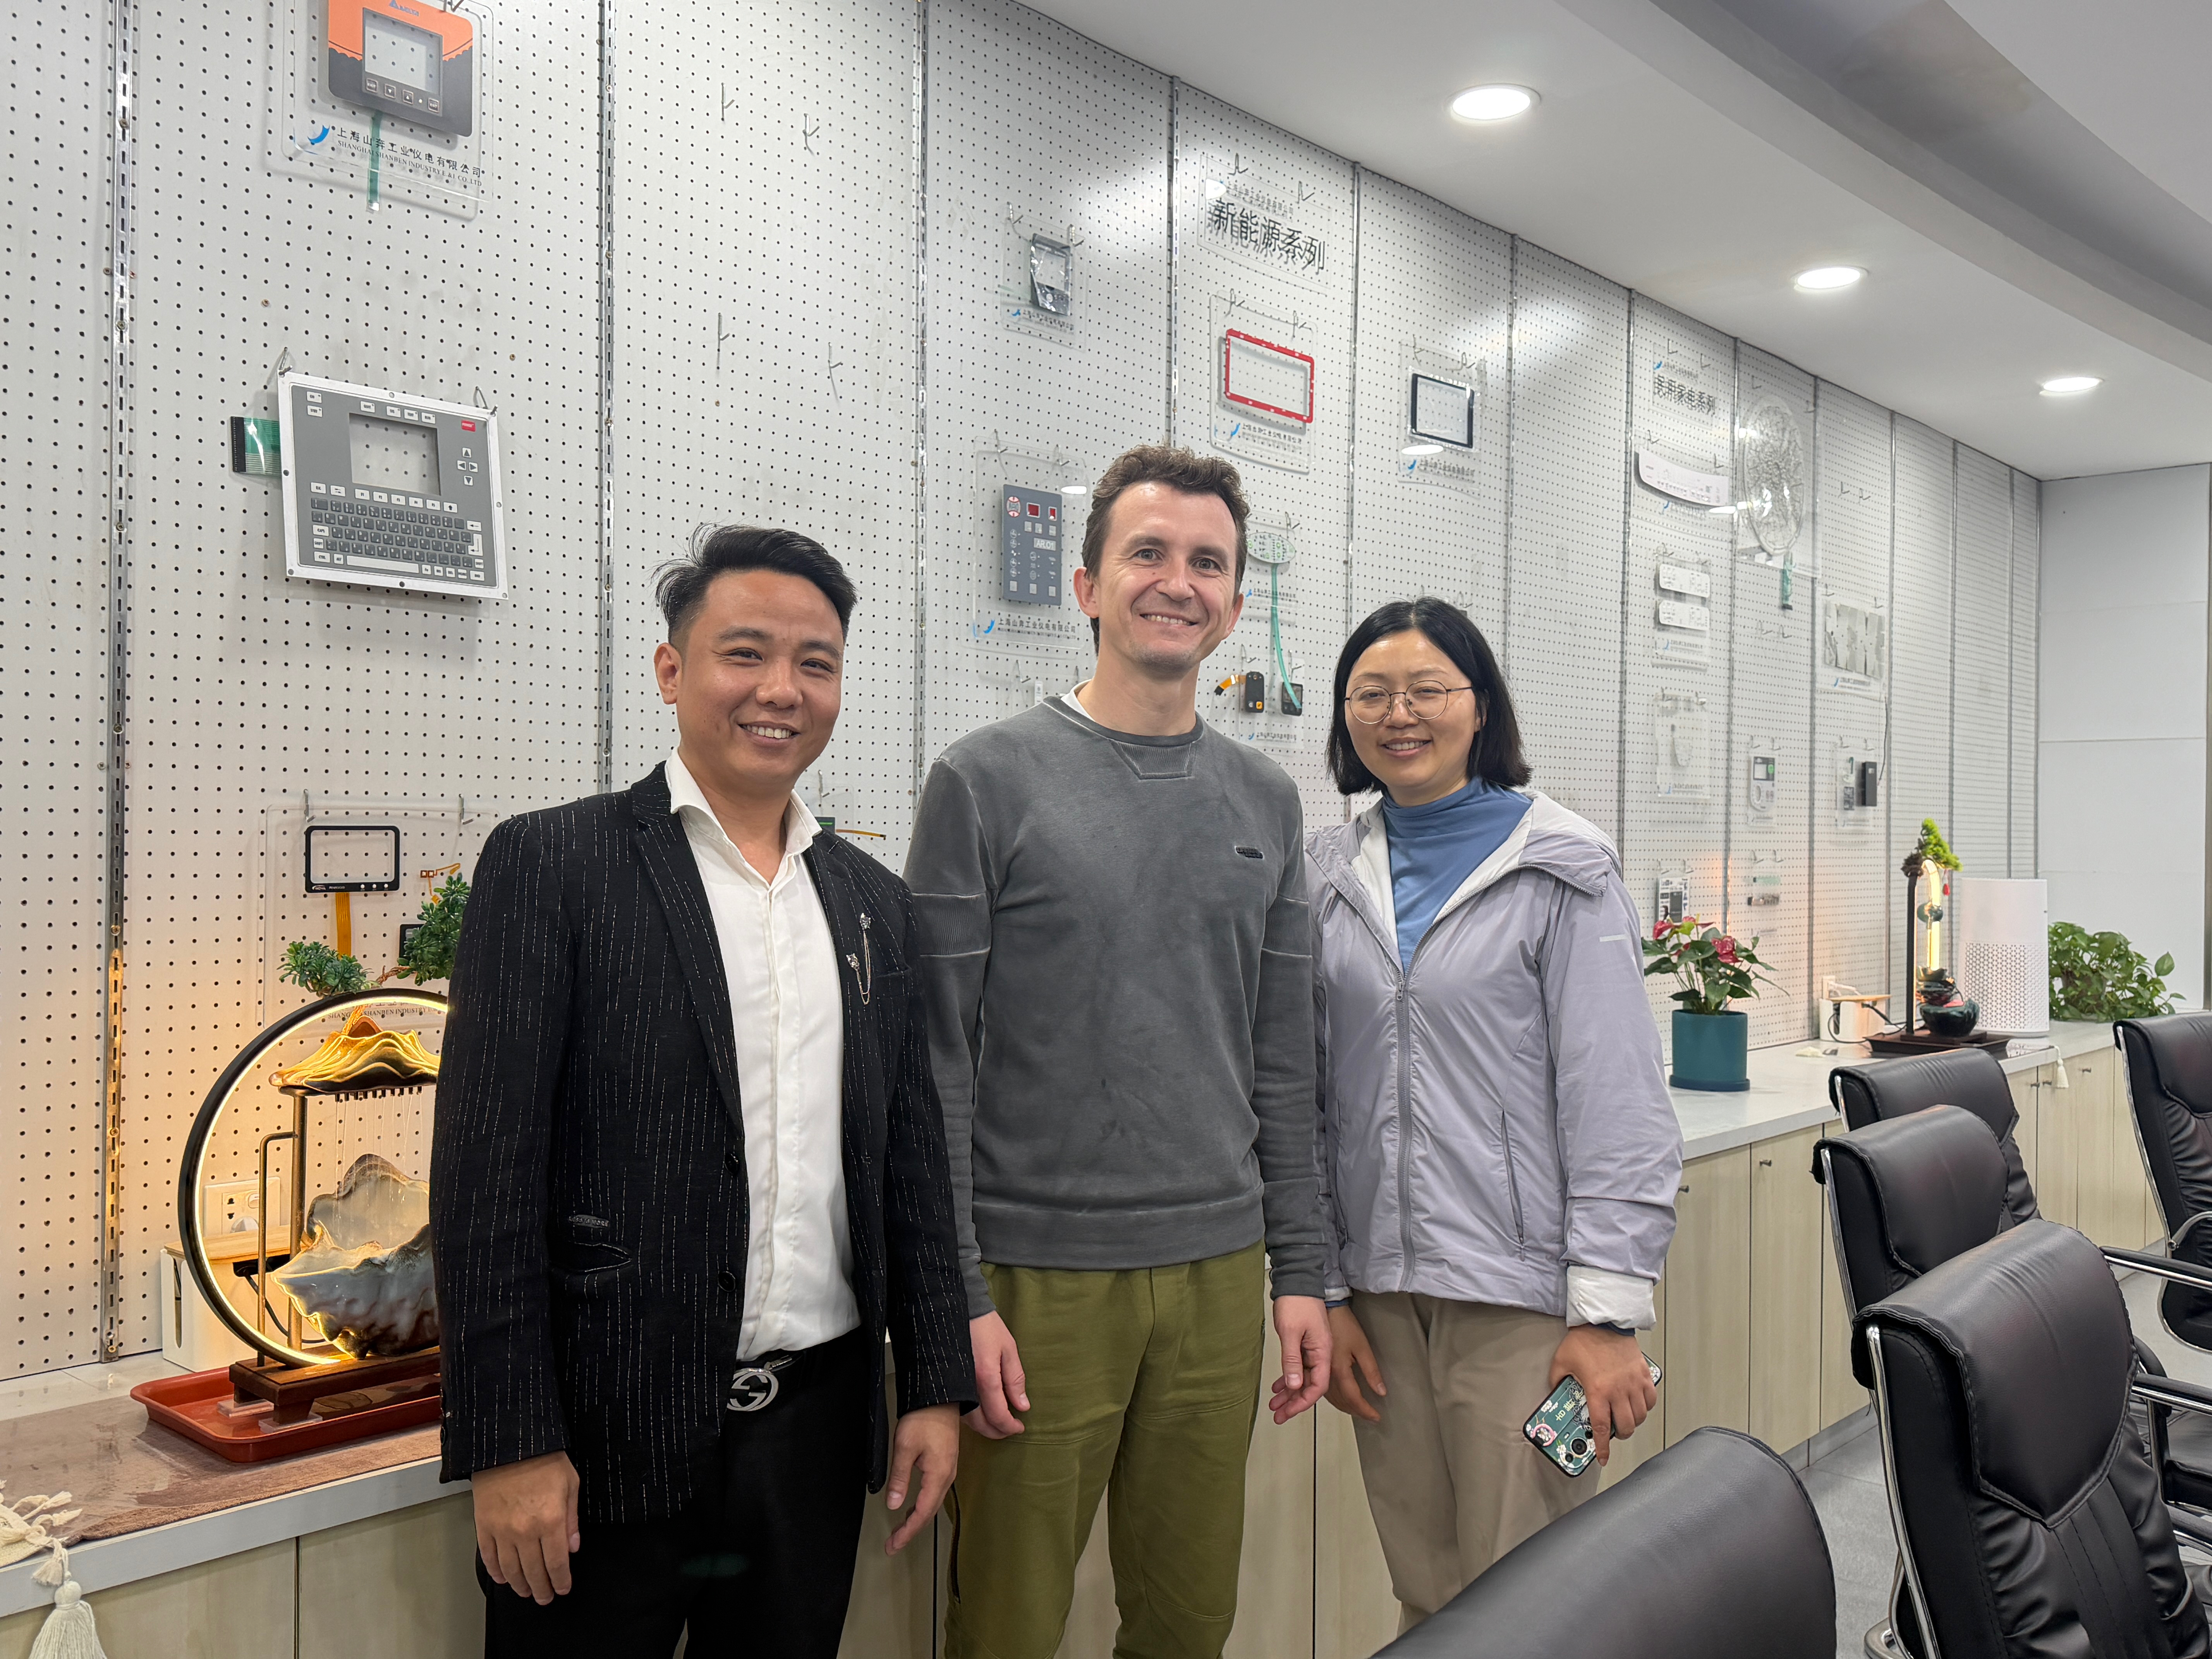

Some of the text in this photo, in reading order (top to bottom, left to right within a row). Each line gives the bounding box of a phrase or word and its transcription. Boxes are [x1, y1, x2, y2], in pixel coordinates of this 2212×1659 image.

[337, 127, 481, 178] 上海山奔工业仪电有限公司
[338, 140, 374, 156] SHANGHAI
[375, 151, 407, 165] SHANBEN
[409, 160, 440, 175] INDUSTRY
[1214, 198, 1325, 271] 新能源系列
[395, 1006, 427, 1014] INDUSTRY
